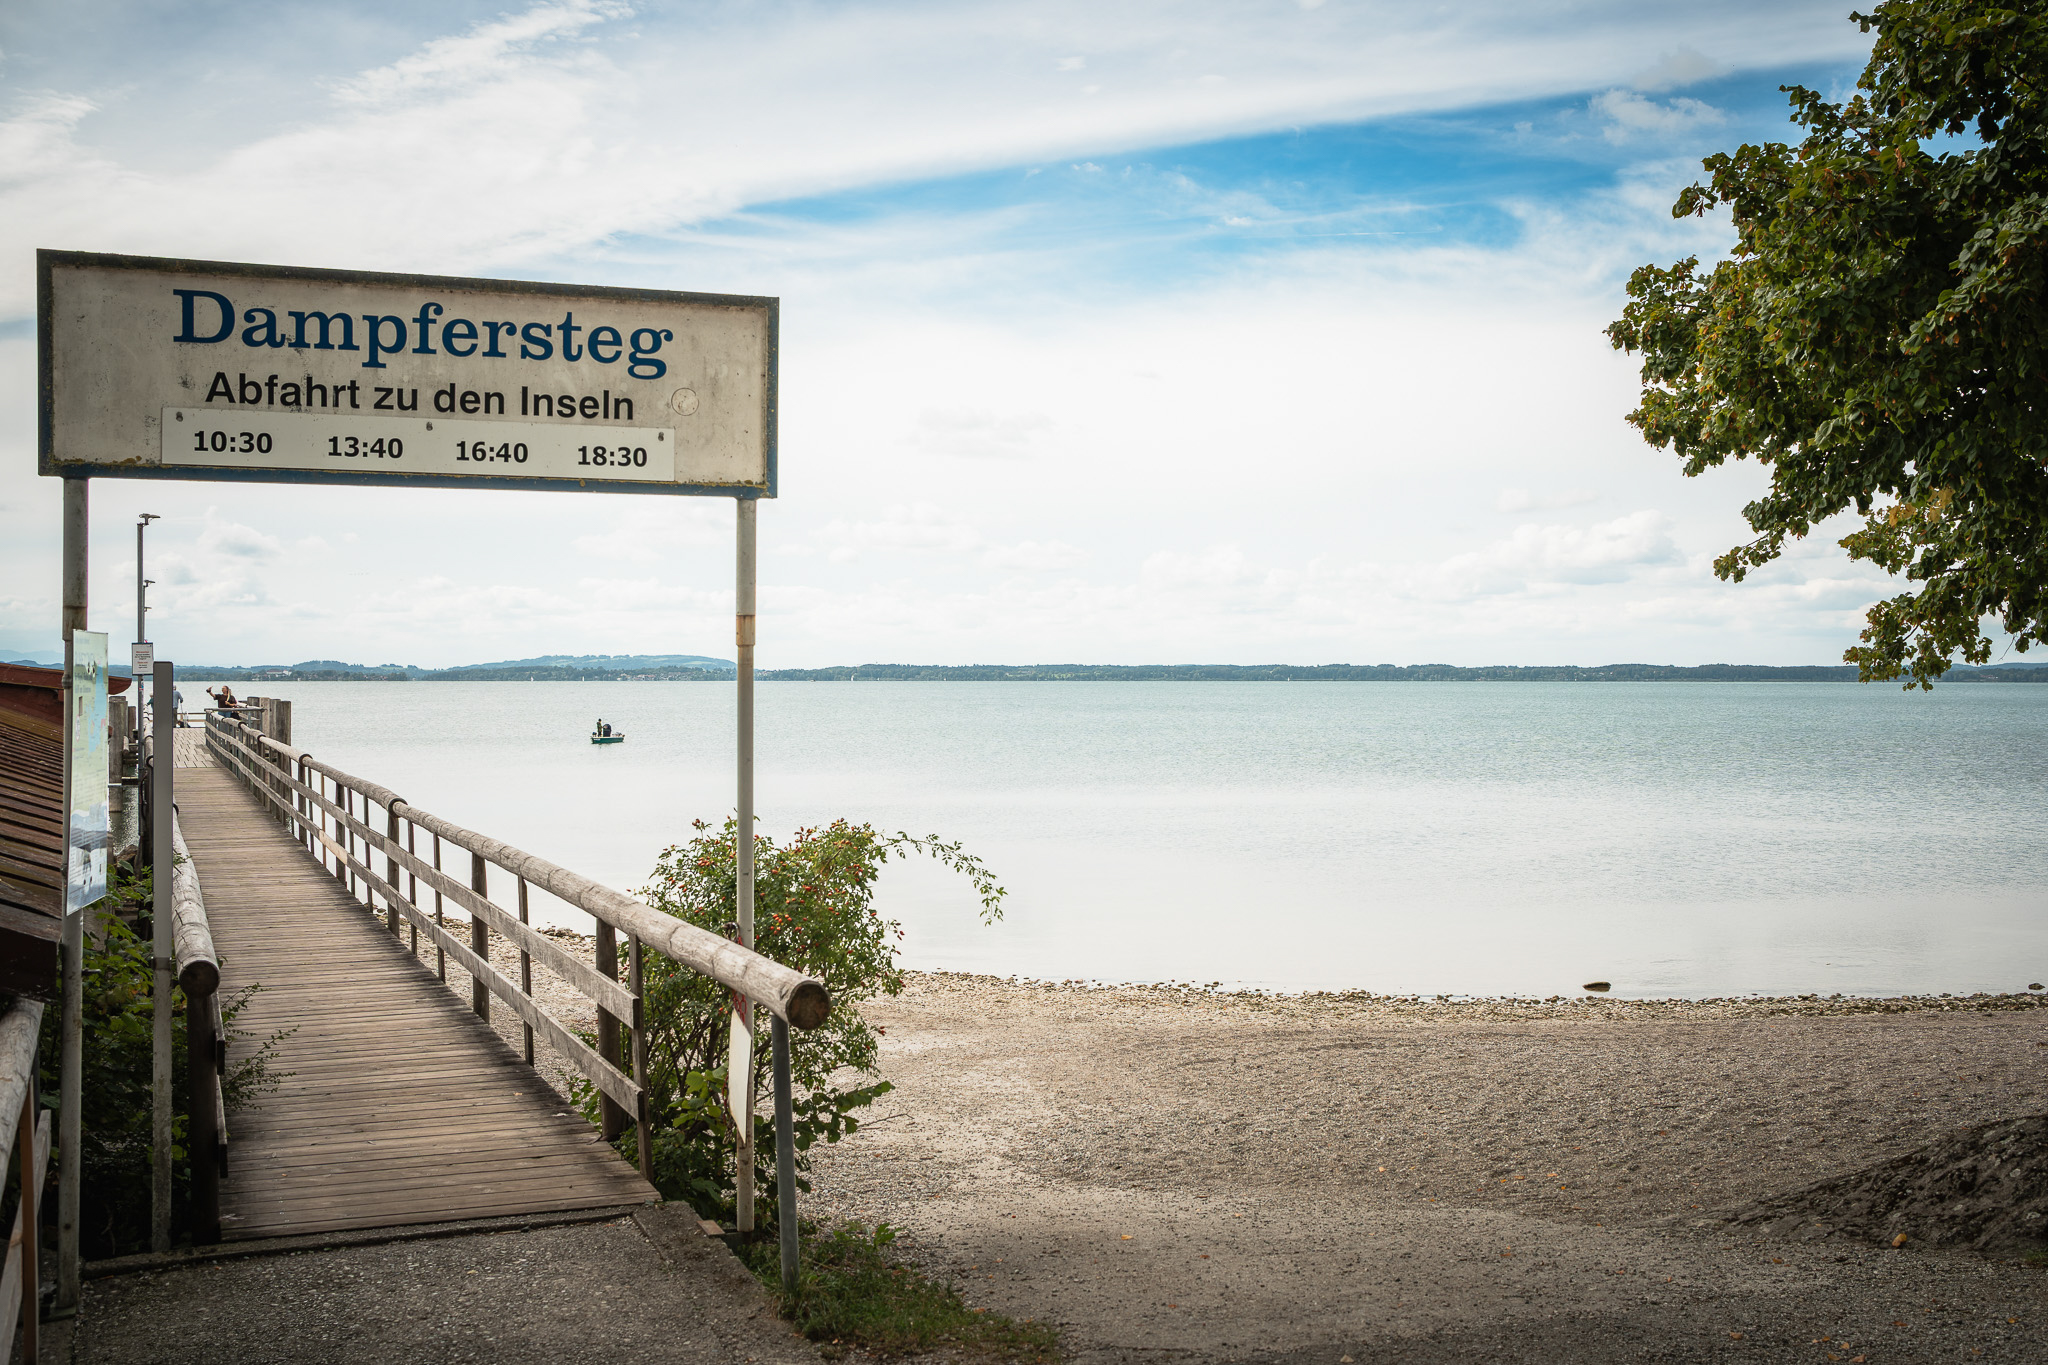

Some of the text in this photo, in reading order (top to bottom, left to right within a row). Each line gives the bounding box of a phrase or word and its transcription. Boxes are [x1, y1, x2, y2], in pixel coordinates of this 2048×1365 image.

[172, 288, 675, 380] Dampfersteg
[204, 370, 634, 421] Abfahrt zu den Inseln
[194, 430, 648, 468] 10:30 13:40 16:40 18:30
